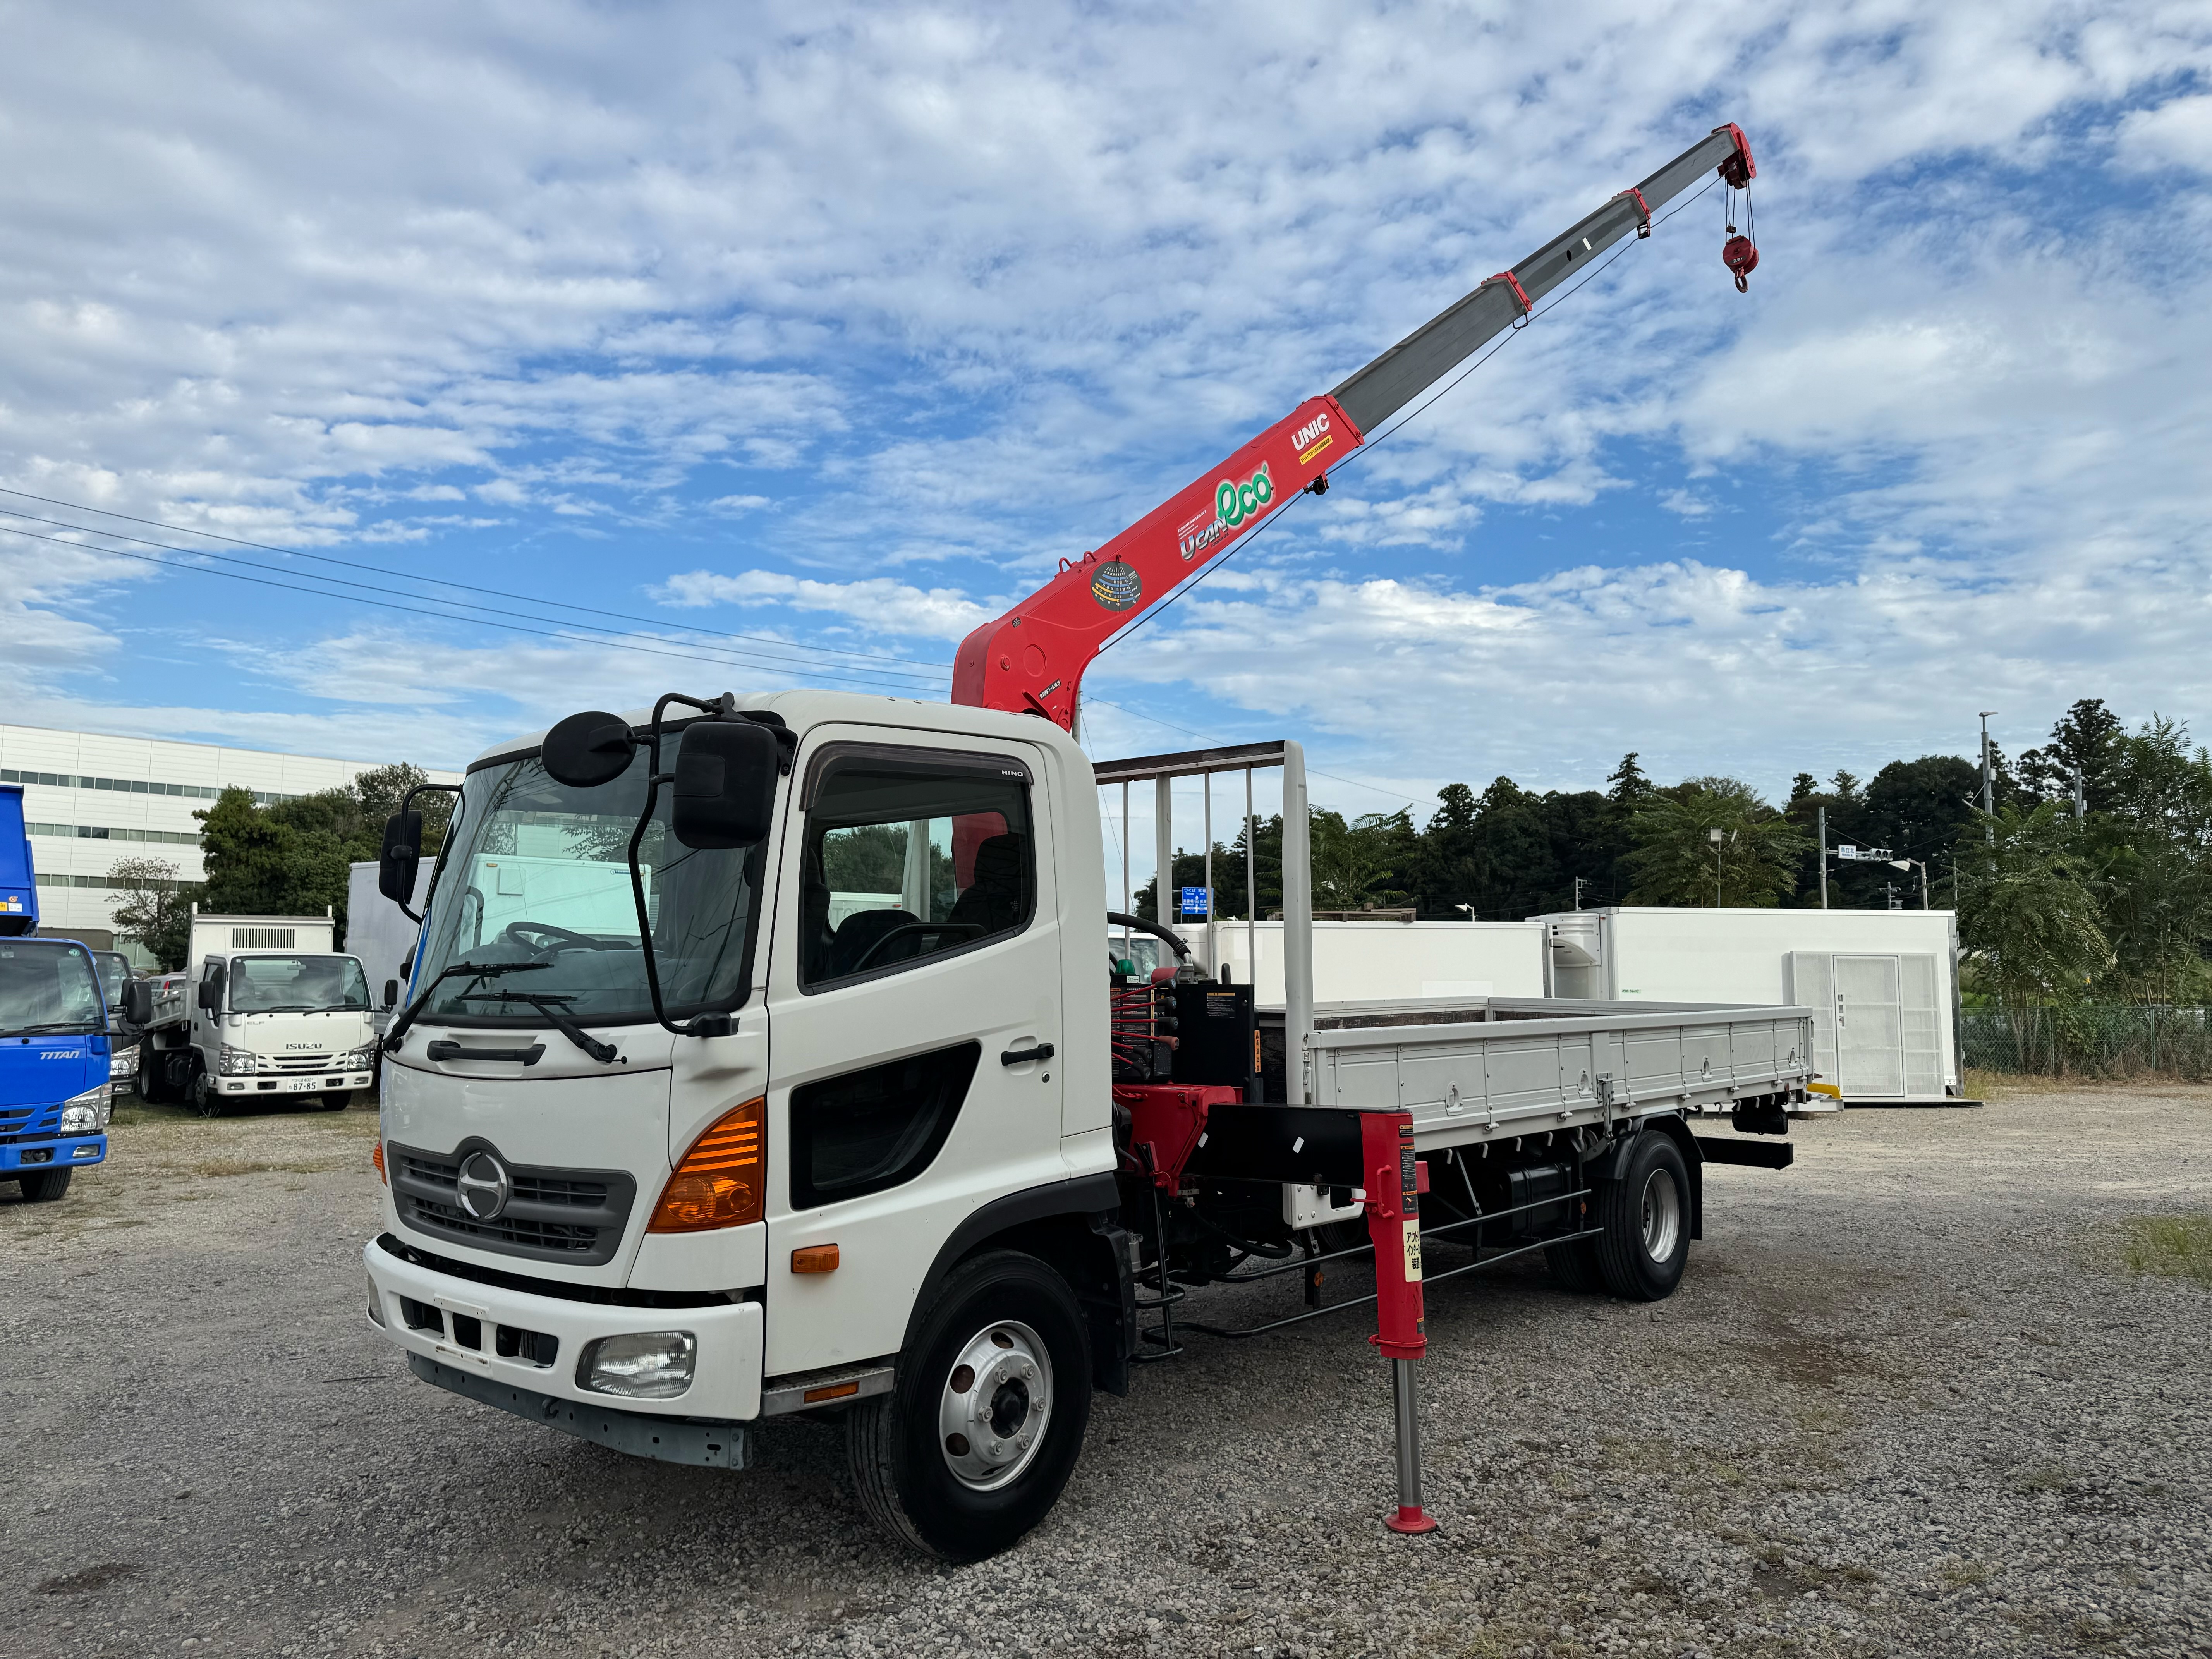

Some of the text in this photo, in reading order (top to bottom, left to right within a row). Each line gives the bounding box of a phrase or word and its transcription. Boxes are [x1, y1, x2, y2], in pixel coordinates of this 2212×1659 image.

[1291, 414, 1329, 450] UNIC
[1217, 473, 1271, 525] eco
[40, 1051, 80, 1060] TITAN
